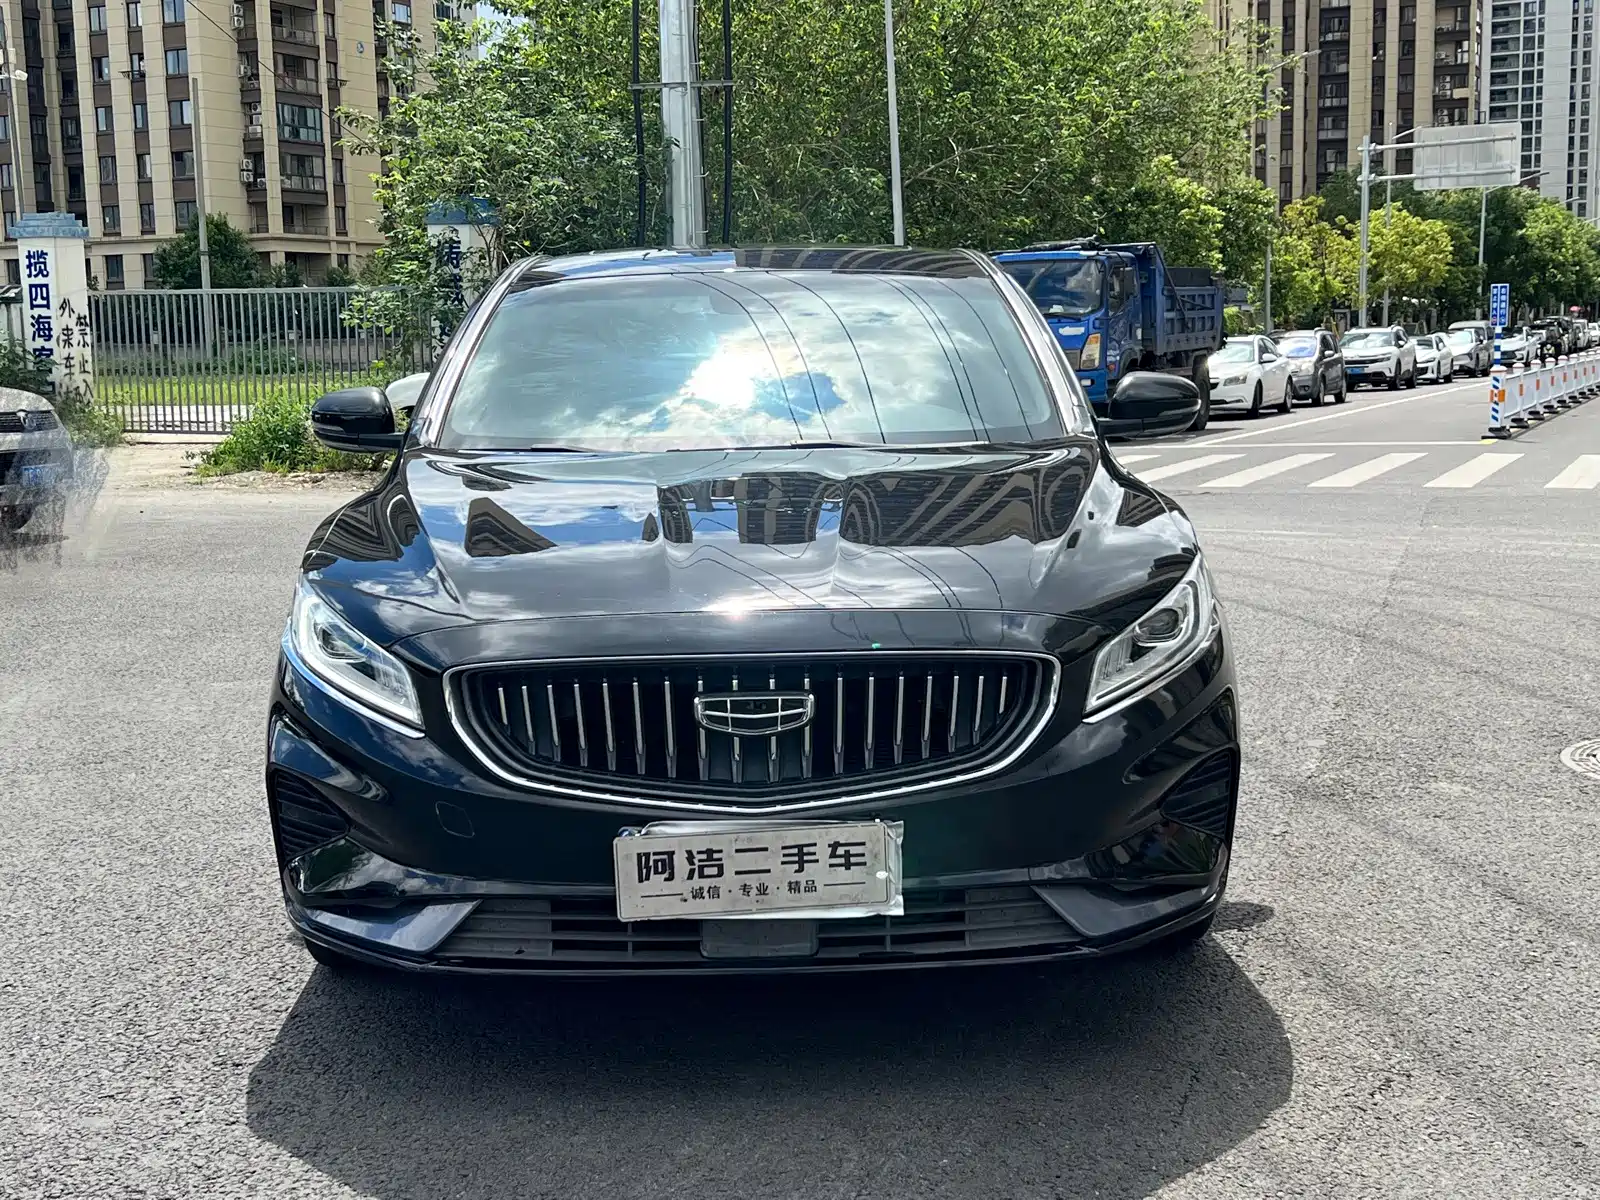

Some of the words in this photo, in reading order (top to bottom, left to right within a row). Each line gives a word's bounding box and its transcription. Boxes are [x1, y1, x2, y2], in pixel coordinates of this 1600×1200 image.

[637, 841, 867, 883] 阿洁二手车
